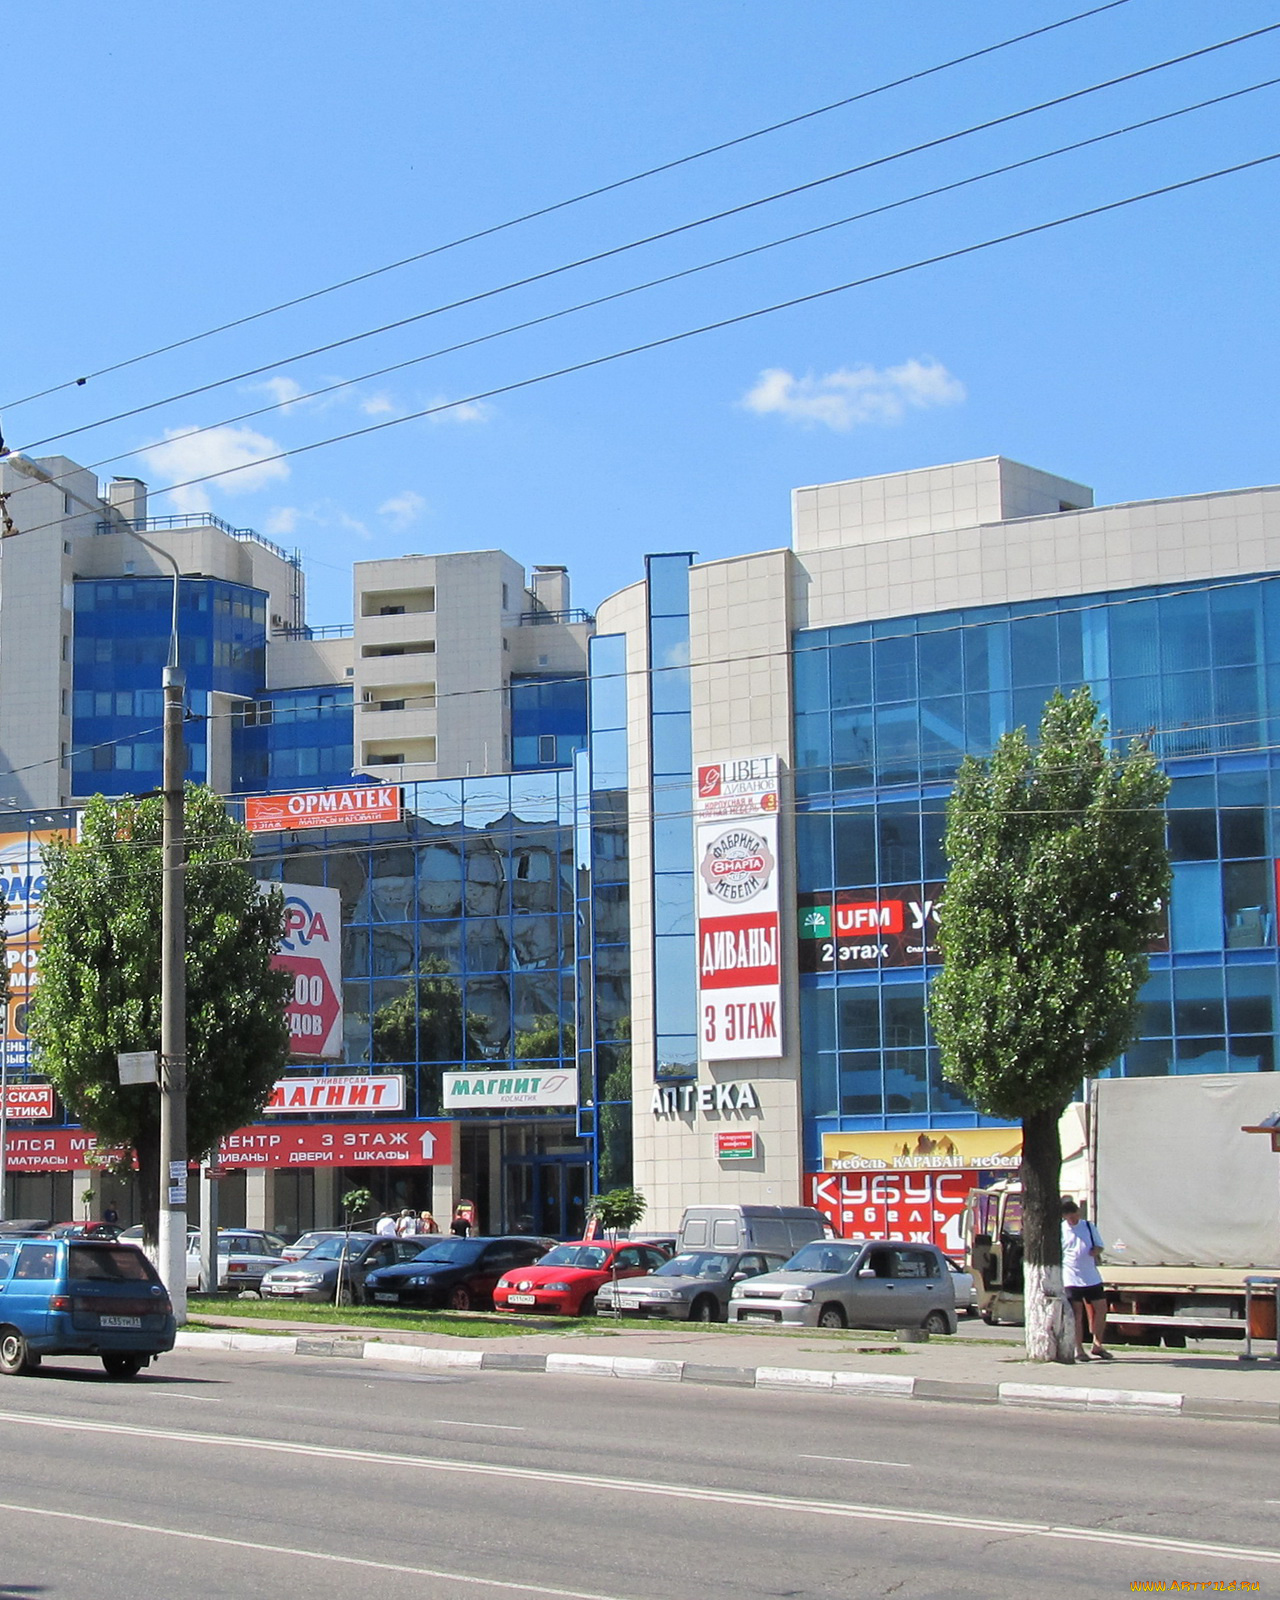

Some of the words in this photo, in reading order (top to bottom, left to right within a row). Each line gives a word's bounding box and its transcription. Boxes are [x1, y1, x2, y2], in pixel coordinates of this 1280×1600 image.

[722, 757, 773, 782] ЦВЕТ
[723, 779, 775, 795] ДИВАНОВ
[287, 788, 393, 815] ОРМАТЕК
[767, 794, 775, 806] 3
[713, 833, 760, 859] ФАБРИКА
[715, 875, 760, 899] МЕБЕЛИ
[837, 907, 890, 930] UFM
[702, 926, 777, 977] ДИВАНЫ
[822, 943, 834, 962] 2
[838, 943, 889, 961] этаж
[705, 1005, 716, 1042] 3
[725, 1001, 777, 1041] ЭТАЖ
[314, 1076, 369, 1085] УНИВЕРСАМ
[451, 1077, 543, 1096] МАГНИТ
[268, 1084, 387, 1107] МАГНИТ
[650, 1083, 756, 1113] АПТЕКА
[321, 1133, 334, 1147] 3
[343, 1131, 409, 1146] ЭТАЖ
[7, 1155, 68, 1166] МАТРАСЫ
[289, 1151, 334, 1163] ДВЕРИ
[353, 1150, 410, 1161] ШКАФЫ
[831, 1155, 886, 1170] мебель
[892, 1155, 965, 1169] КАРАВАН
[812, 1173, 964, 1205] КУБУС
